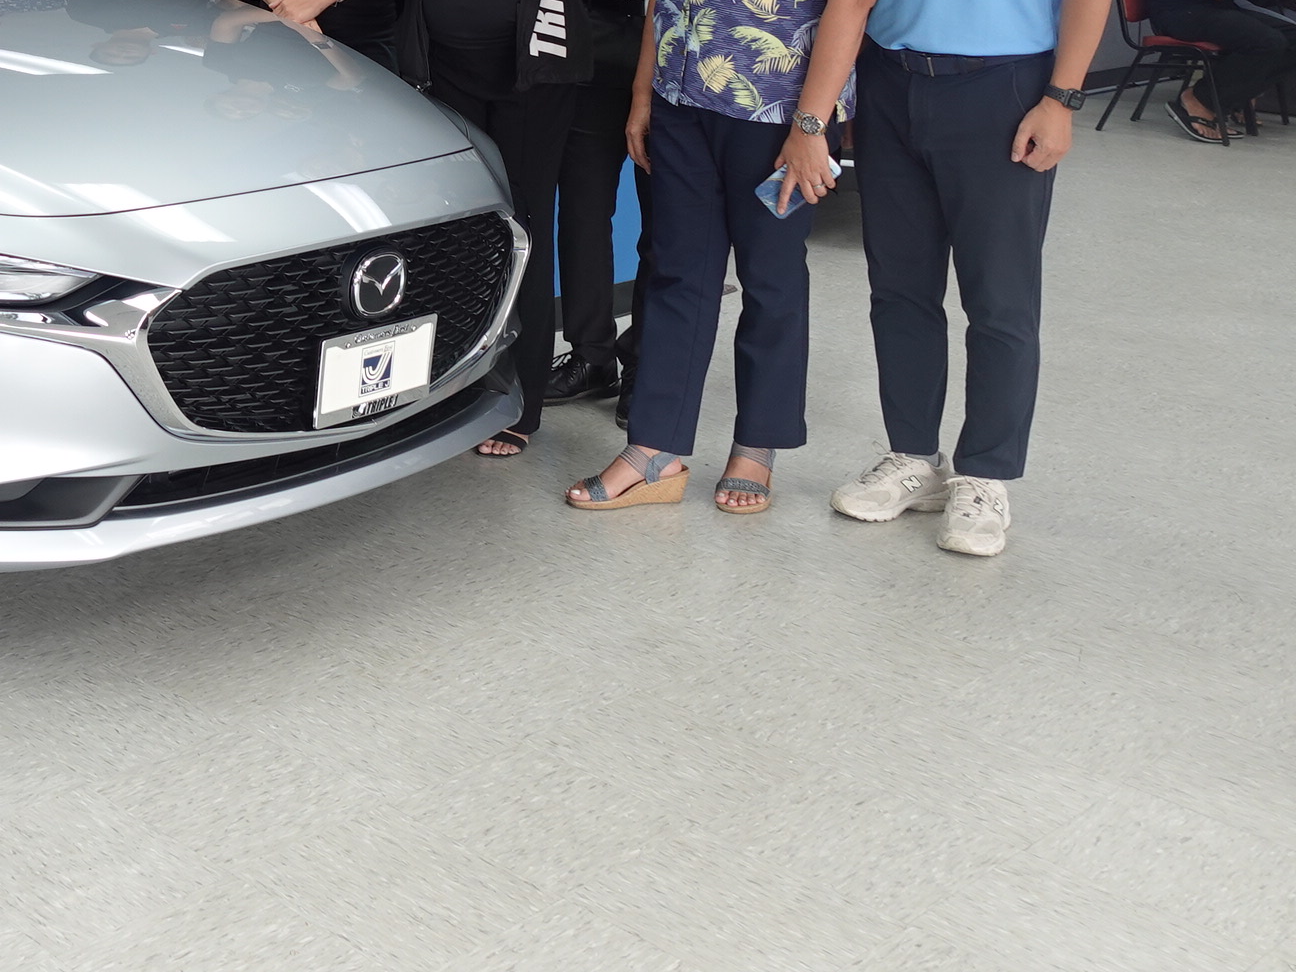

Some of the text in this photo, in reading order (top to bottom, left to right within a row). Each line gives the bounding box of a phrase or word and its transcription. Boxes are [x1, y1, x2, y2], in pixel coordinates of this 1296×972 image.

[361, 380, 390, 395] TRIPLE J
[366, 394, 399, 415] TRIPLE J
[900, 474, 923, 493] N
